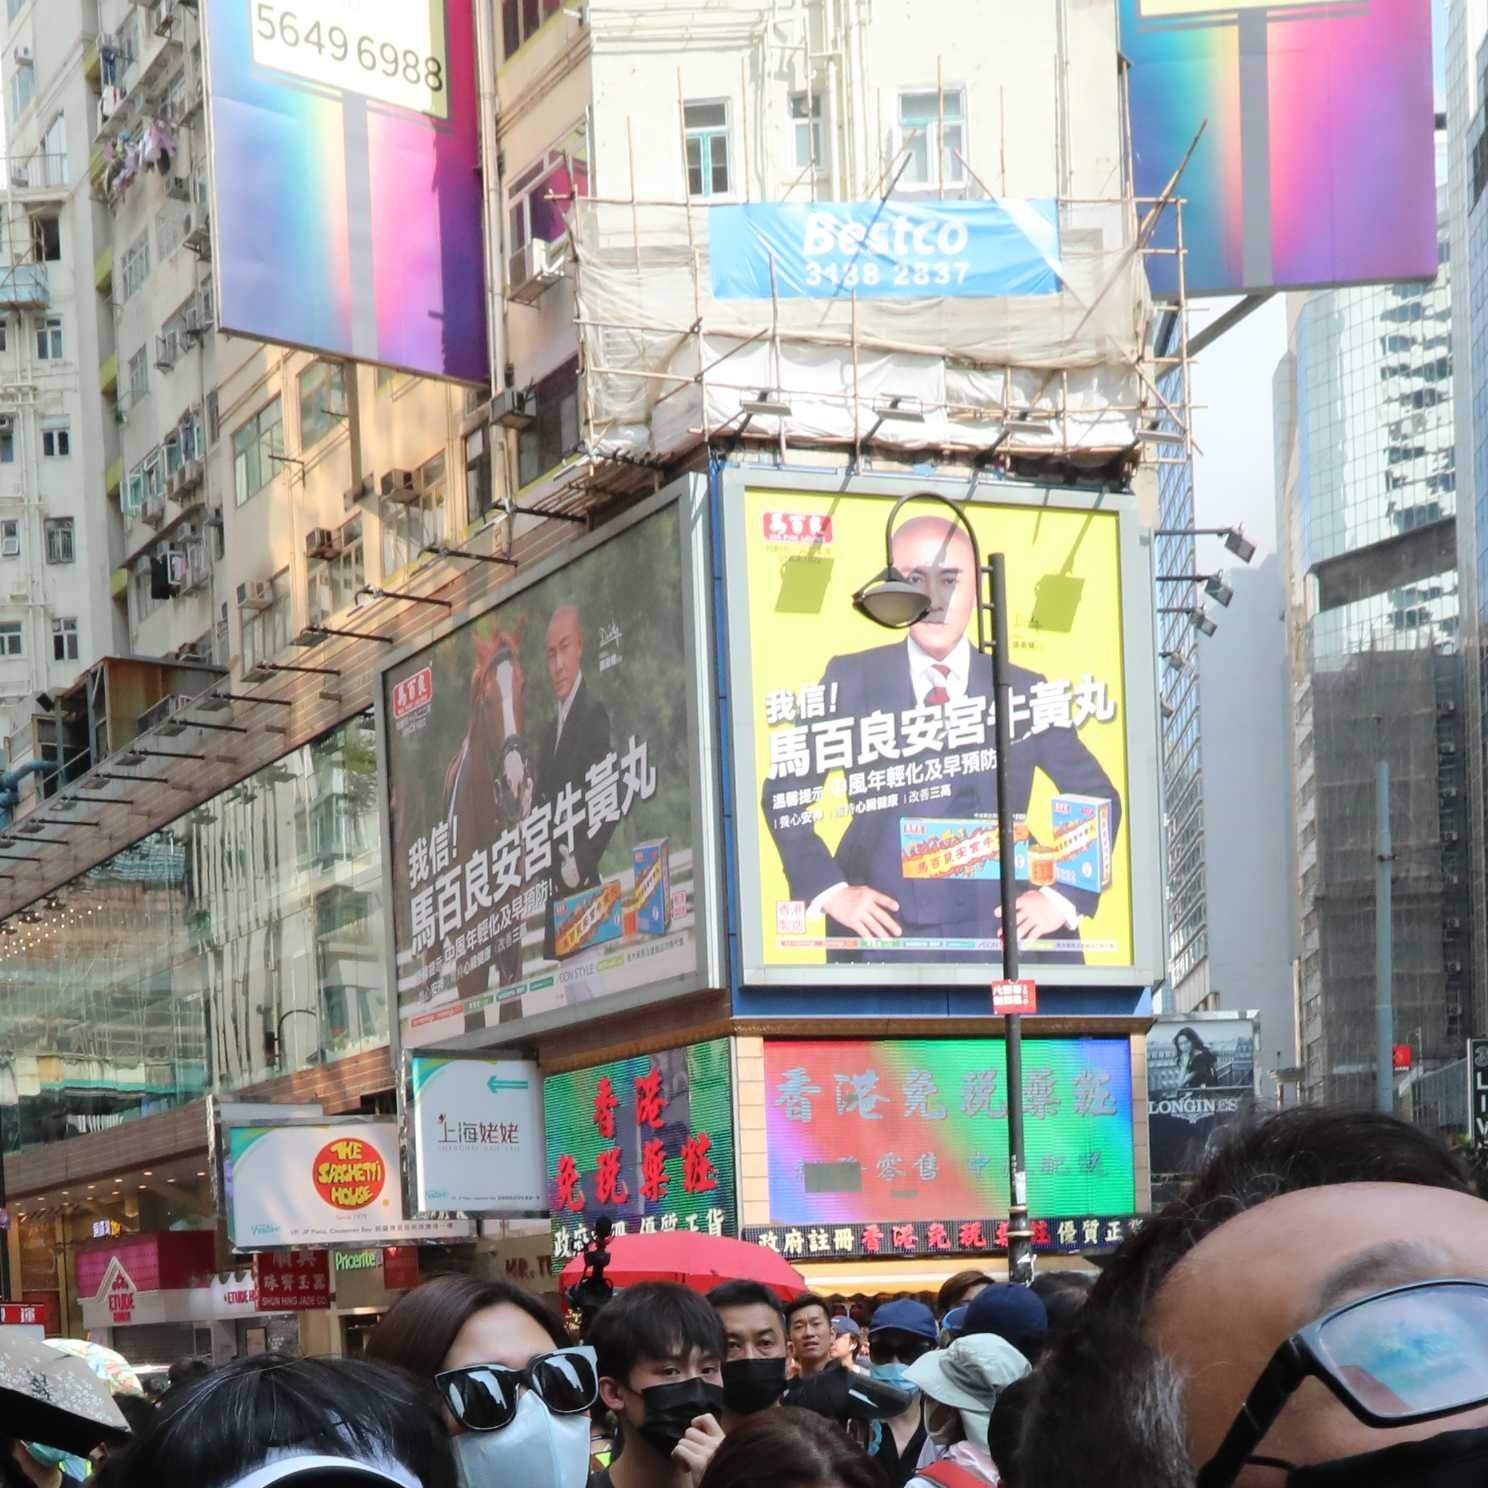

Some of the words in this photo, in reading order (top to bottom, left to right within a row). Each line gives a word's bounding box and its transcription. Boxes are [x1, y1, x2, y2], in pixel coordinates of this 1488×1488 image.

[257, 3, 349, 62] 5649
[357, 35, 443, 92] 6988
[802, 212, 969, 256] Bestco
[893, 260, 969, 287] 2837
[765, 682, 839, 724] 我信!
[409, 815, 459, 890] 我信!
[410, 735, 657, 954] 馬百良安宮牛黃丸
[593, 1067, 668, 1139] 香港
[1148, 1098, 1238, 1114] LONGINES
[331, 1142, 362, 1160] THE
[438, 1121, 520, 1144] 上海姥姥
[793, 1152, 940, 1181] 零售
[331, 1186, 373, 1206] HOUSE
[555, 1220, 627, 1257] 政府冊
